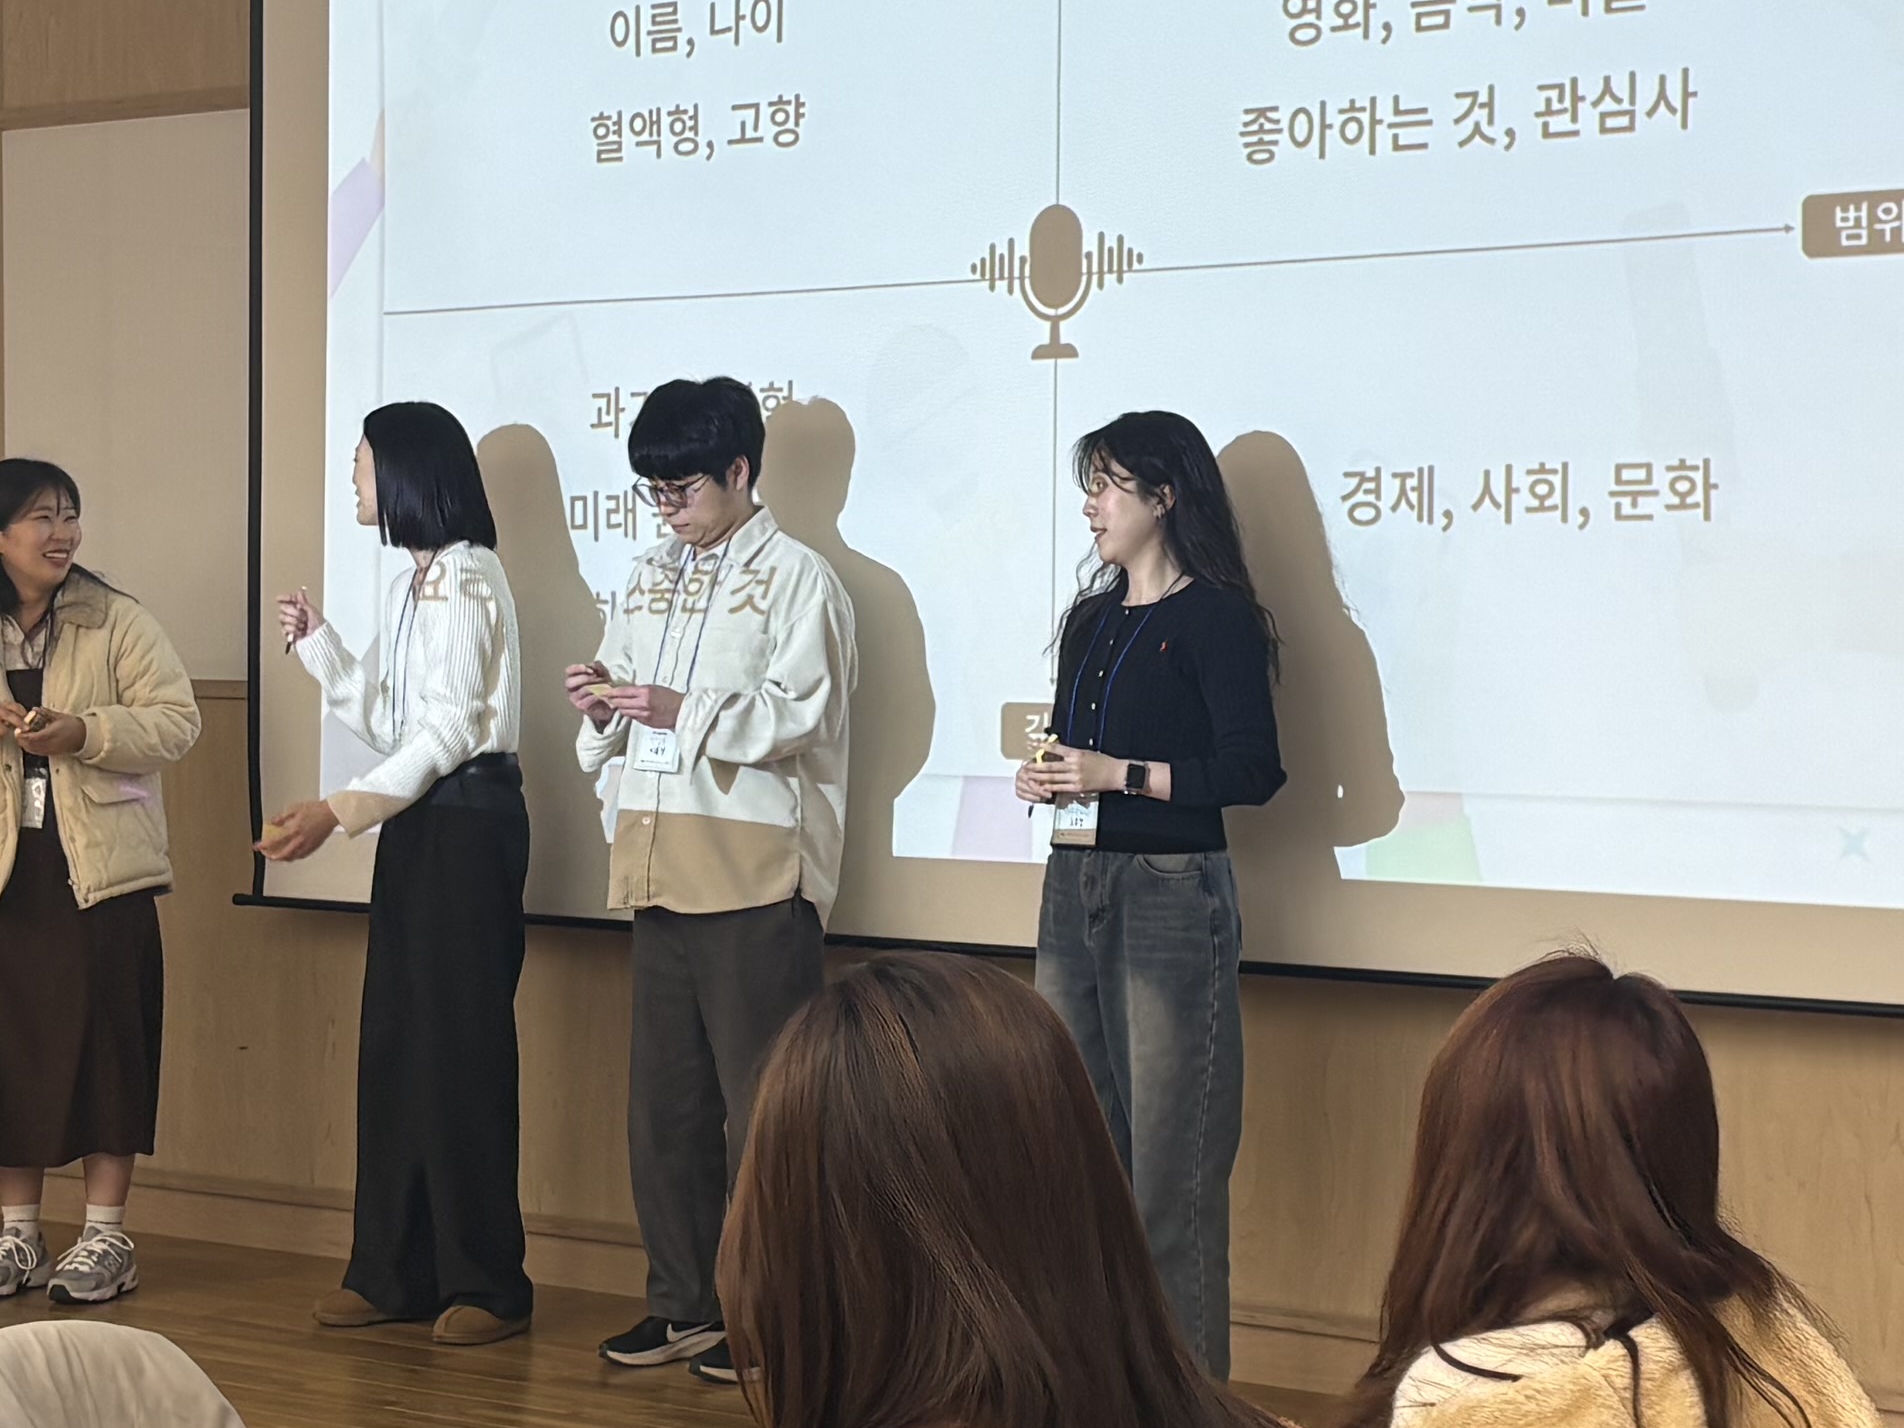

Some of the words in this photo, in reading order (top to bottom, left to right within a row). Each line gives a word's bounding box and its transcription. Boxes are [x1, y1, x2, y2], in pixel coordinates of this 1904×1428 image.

[609, 0, 697, 59] 이름,
[590, 103, 716, 164] 혈액형,
[726, 92, 806, 150] 고향
[1238, 93, 1434, 166] 좋아하는
[1451, 83, 1518, 151] 것,
[1533, 66, 1700, 142] 관심사
[569, 490, 638, 542] 미래
[1338, 464, 1455, 532] 경제,
[1469, 460, 1592, 530] 사회,
[1607, 457, 1720, 523] 문화
